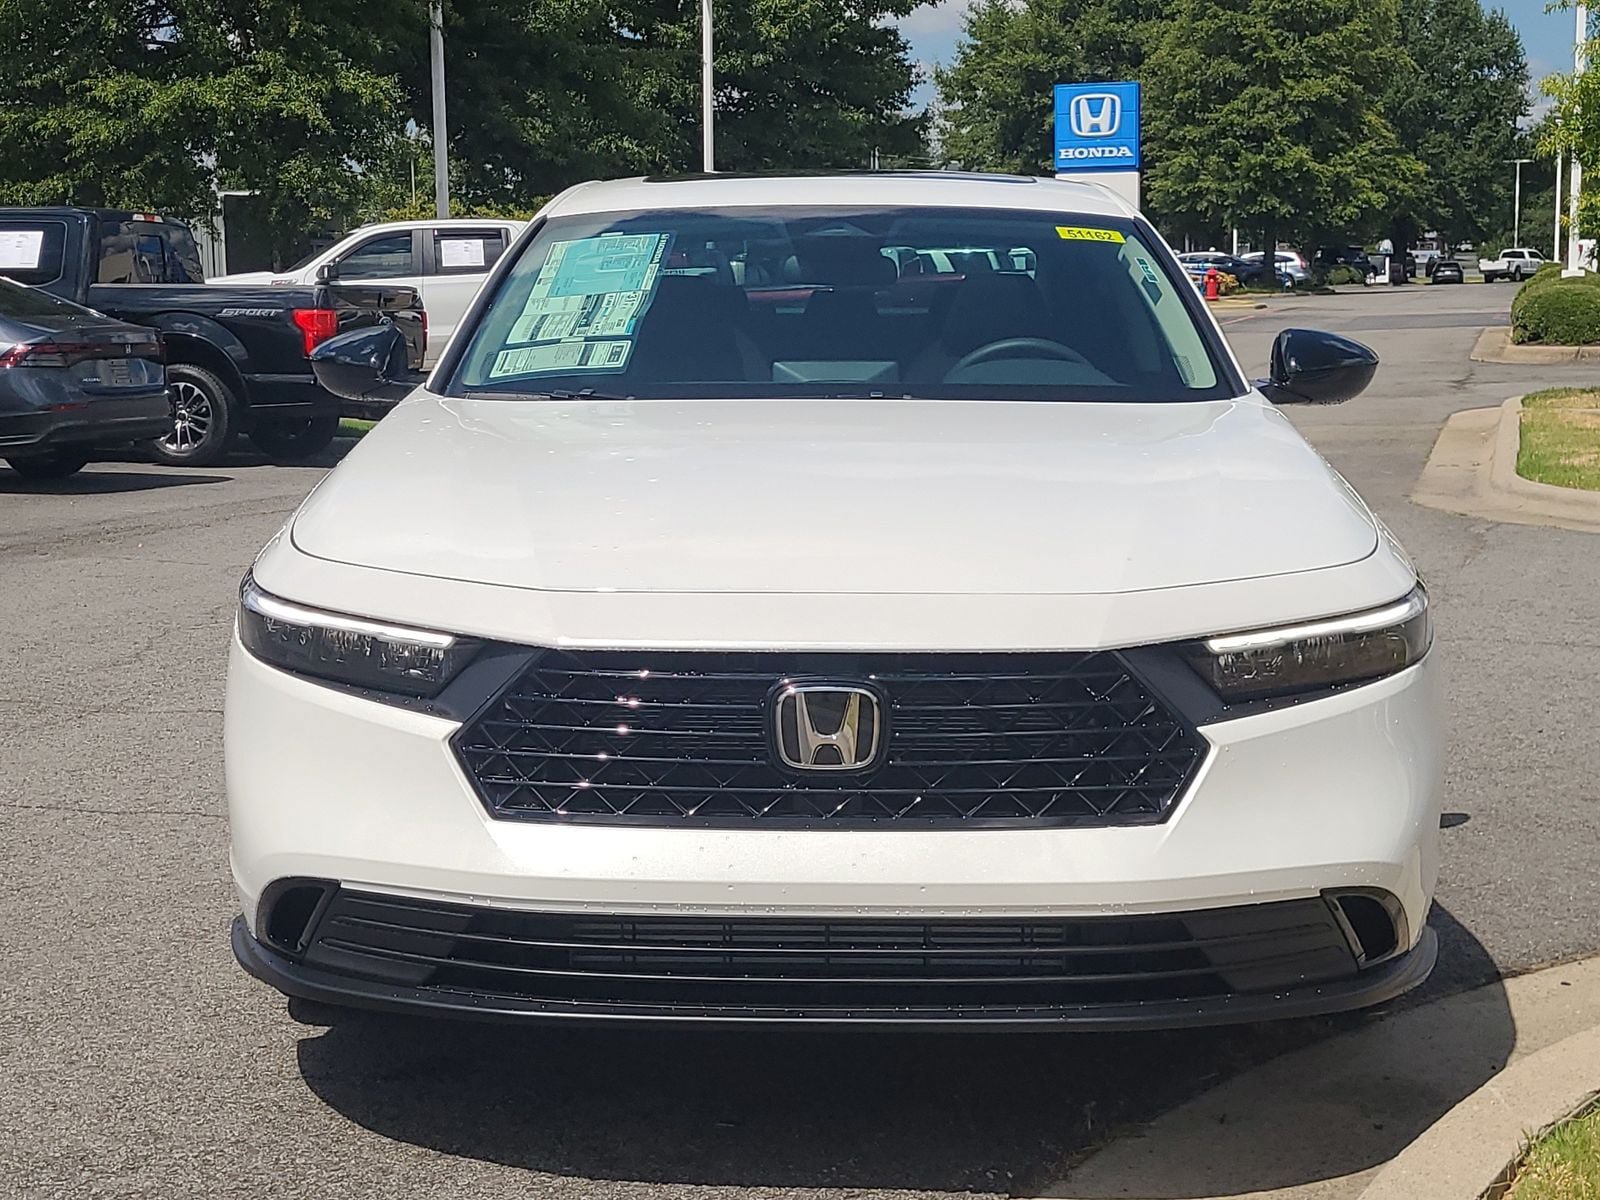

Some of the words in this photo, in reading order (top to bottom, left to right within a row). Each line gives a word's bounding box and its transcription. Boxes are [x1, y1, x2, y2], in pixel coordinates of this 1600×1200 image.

[1058, 146, 1134, 159] HONDA
[1067, 229, 1115, 241] 51162
[652, 239, 667, 263] HONDA
[216, 308, 284, 318] SPORT
